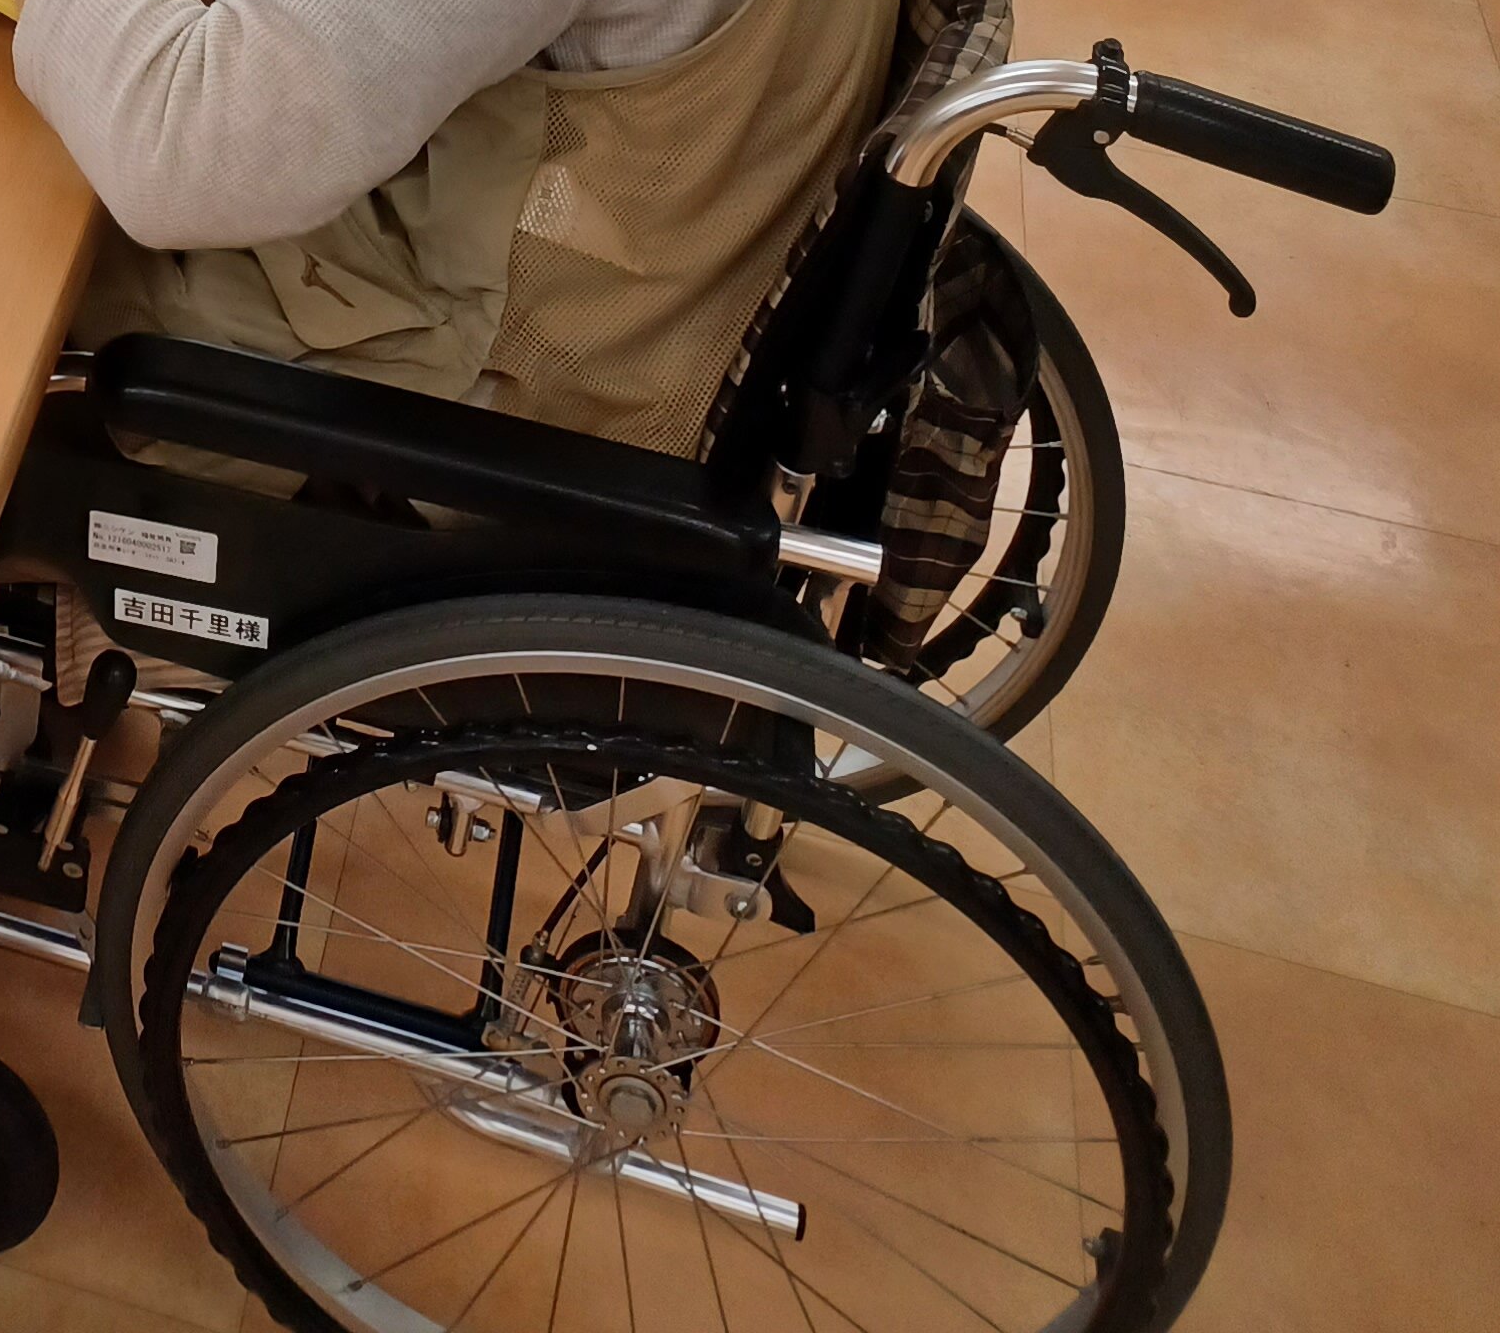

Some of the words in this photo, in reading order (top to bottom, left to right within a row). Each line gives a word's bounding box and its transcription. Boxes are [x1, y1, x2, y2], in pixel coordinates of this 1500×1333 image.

[121, 597, 261, 642] 吉田千里様
